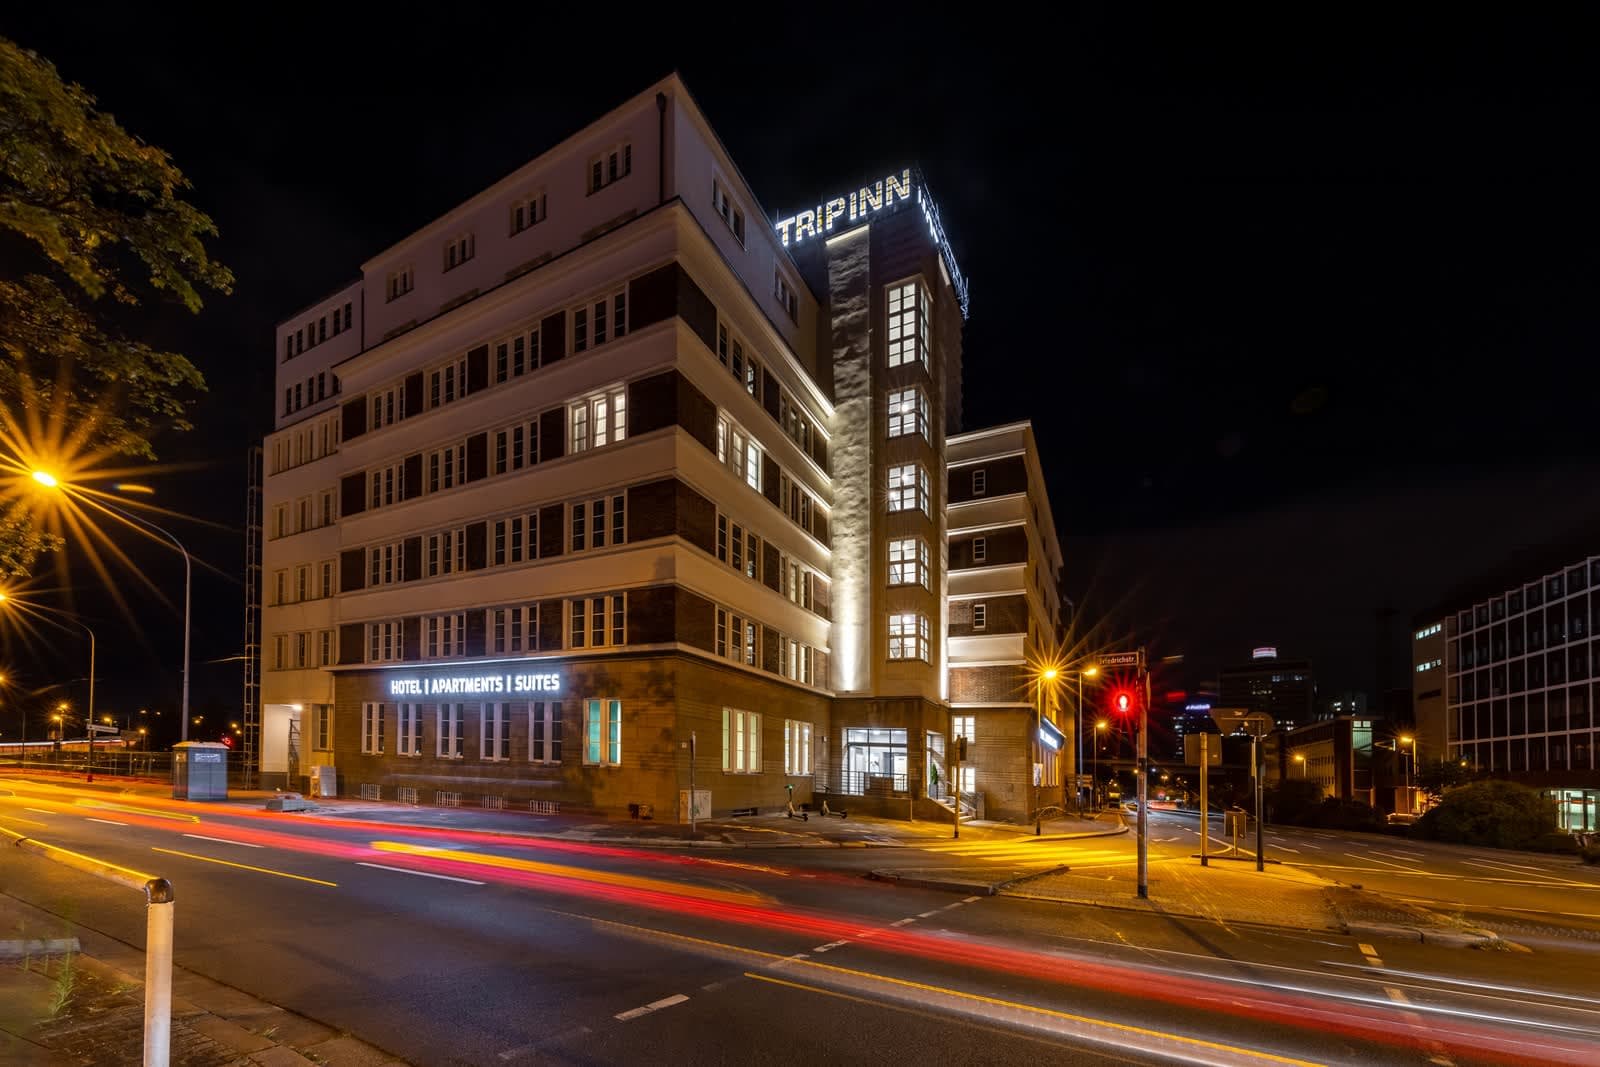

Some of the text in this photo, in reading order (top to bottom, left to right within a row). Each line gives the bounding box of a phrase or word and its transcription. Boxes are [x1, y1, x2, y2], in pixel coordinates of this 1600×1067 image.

[391, 680, 422, 694] HOTEL
[431, 677, 503, 693] APARTMENTS
[515, 674, 561, 691] SUITES
